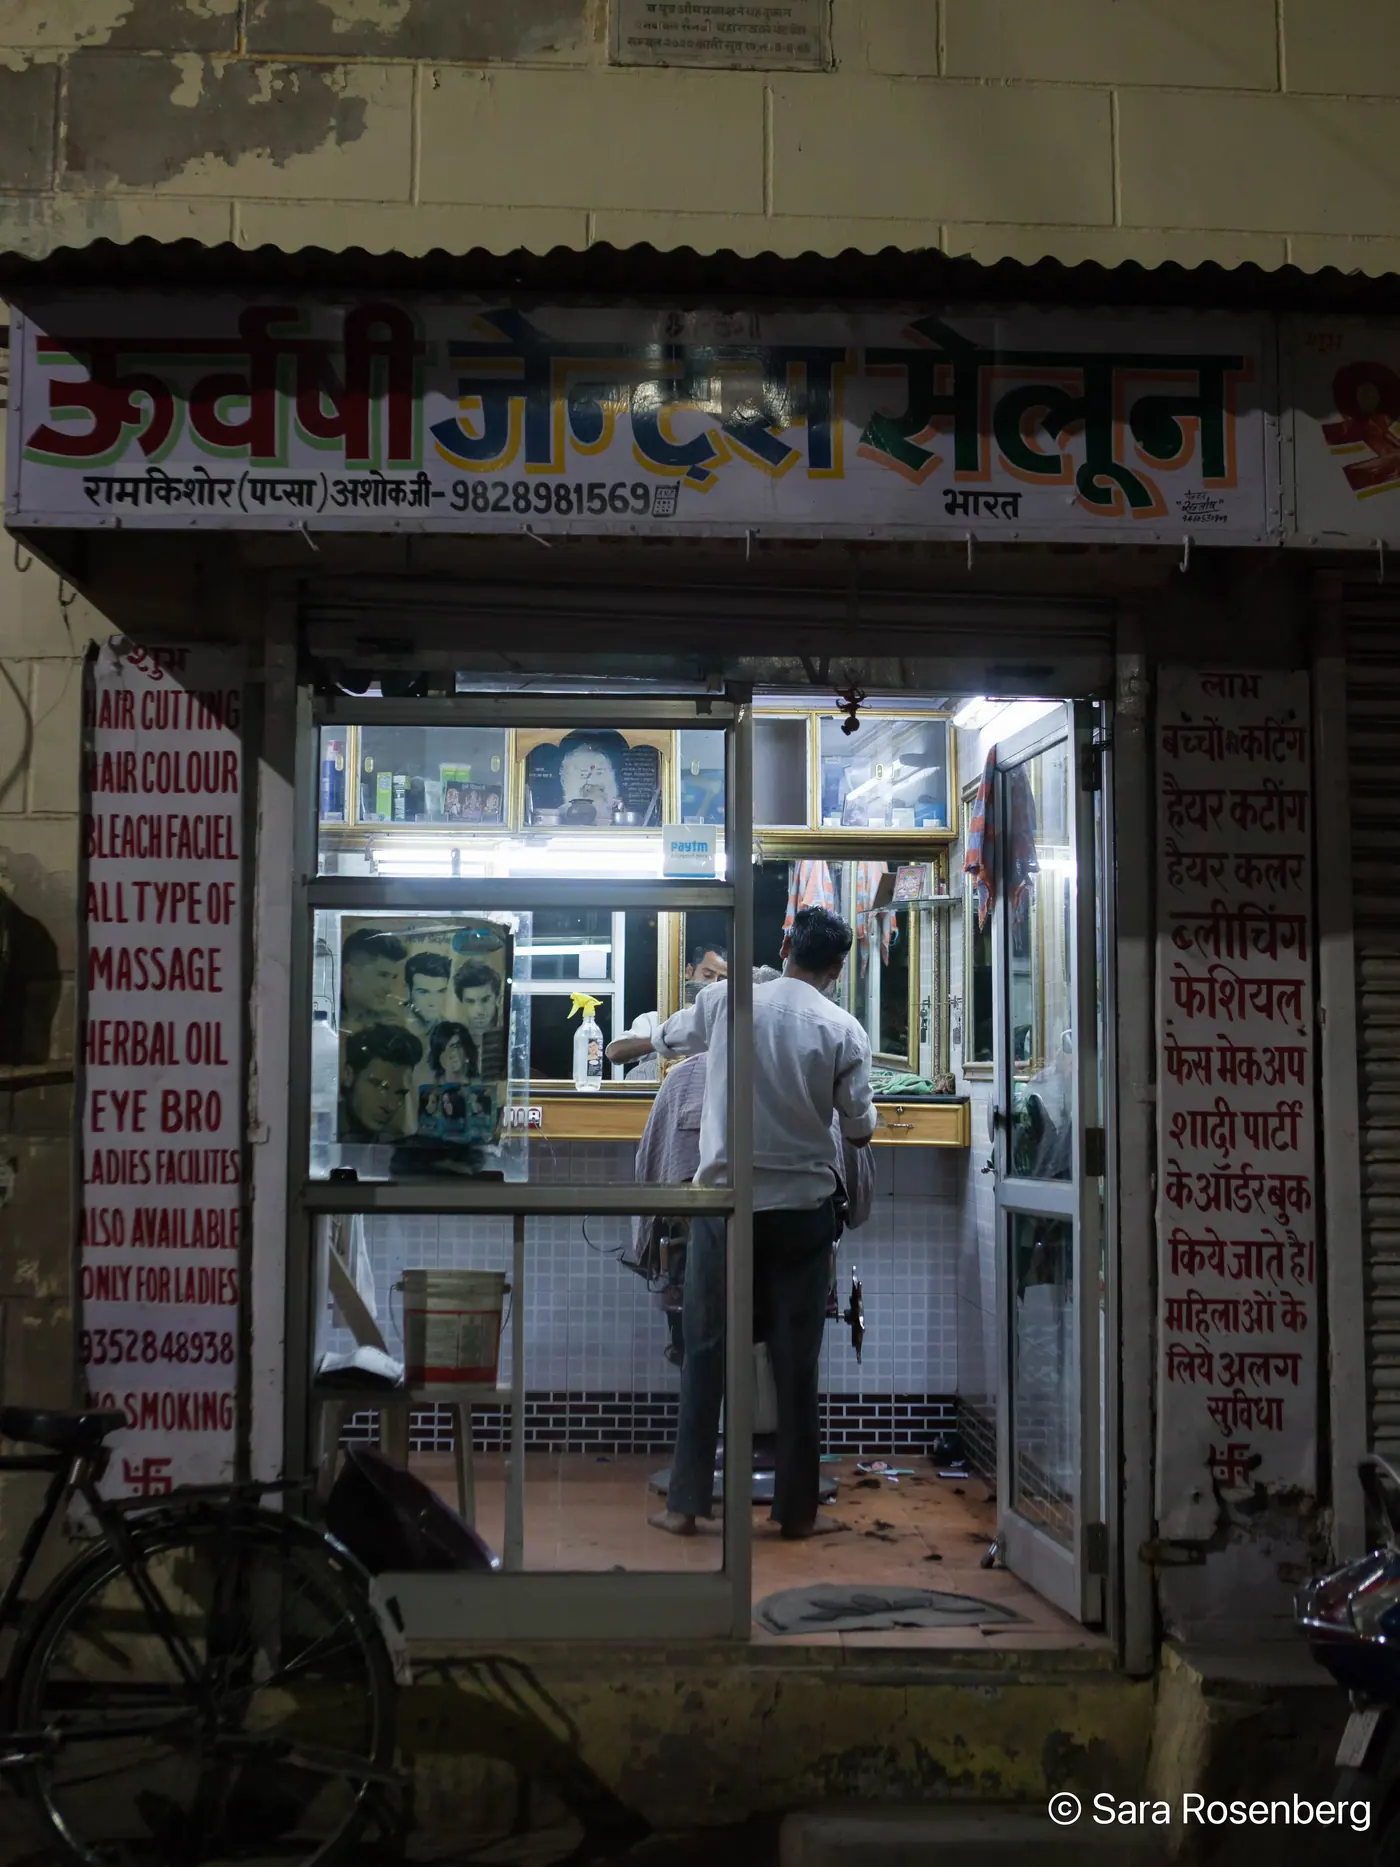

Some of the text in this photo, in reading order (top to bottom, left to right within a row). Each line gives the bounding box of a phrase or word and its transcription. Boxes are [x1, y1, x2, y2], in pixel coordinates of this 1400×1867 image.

[858, 314, 1252, 516] सेलून
[83, 466, 235, 508] रामकिशोर
[451, 478, 651, 515] 9828981569
[942, 487, 1022, 518] भारत
[1199, 672, 1262, 699] लाभ
[141, 689, 241, 731] CUTTING
[142, 750, 239, 793] COLOUR
[82, 814, 239, 860] BLEACH FACIEL
[1234, 853, 1307, 894] कलर
[85, 881, 236, 925] ALL TYPE OF
[87, 946, 223, 993] MASSAGE
[81, 1019, 229, 1067] HERBAL OIL
[1164, 1032, 1213, 1086] फेस
[90, 1089, 222, 1133] EYE BRO
[1169, 1095, 1304, 1159] शादी पार्टी
[1165, 1158, 1193, 1212] के
[1268, 1174, 1312, 1226] बुक
[131, 1207, 241, 1249] AVAILABLE
[1168, 1227, 1227, 1277] किये
[1227, 1228, 1284, 1287] जाते
[80, 1264, 239, 1306] ONLY FOR LADIES
[1165, 1288, 1308, 1343] महिलाओं के
[79, 1328, 234, 1365] 9352848938
[1166, 1343, 1303, 1387] लिये अलग
[124, 1391, 234, 1431] SMOKING
[1207, 1388, 1285, 1438] सुविधा
